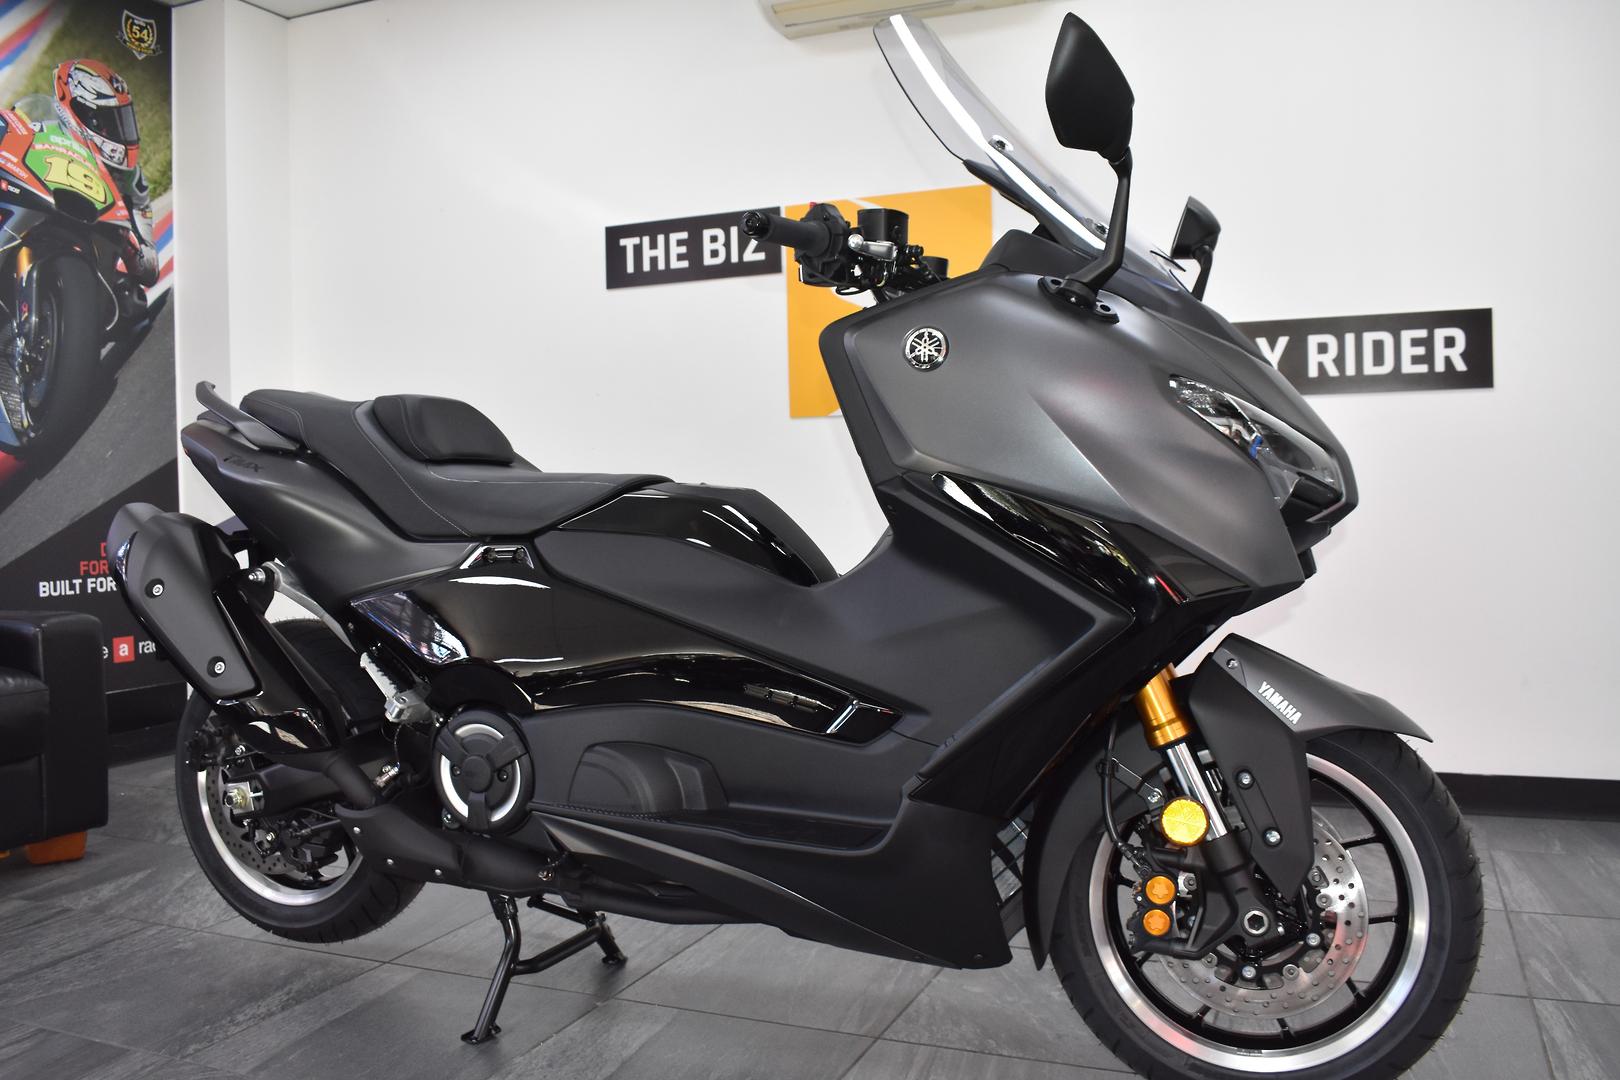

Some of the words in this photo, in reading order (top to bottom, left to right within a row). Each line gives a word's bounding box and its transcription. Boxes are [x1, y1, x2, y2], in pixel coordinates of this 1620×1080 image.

[132, 25, 149, 41] 54
[619, 231, 689, 274] THE
[1307, 327, 1468, 378] RIDER
[80, 560, 109, 575] FOR
[39, 579, 82, 597] BUILT
[87, 577, 117, 593] FOR
[118, 643, 129, 656] a
[1258, 681, 1302, 725] YAMAHA
